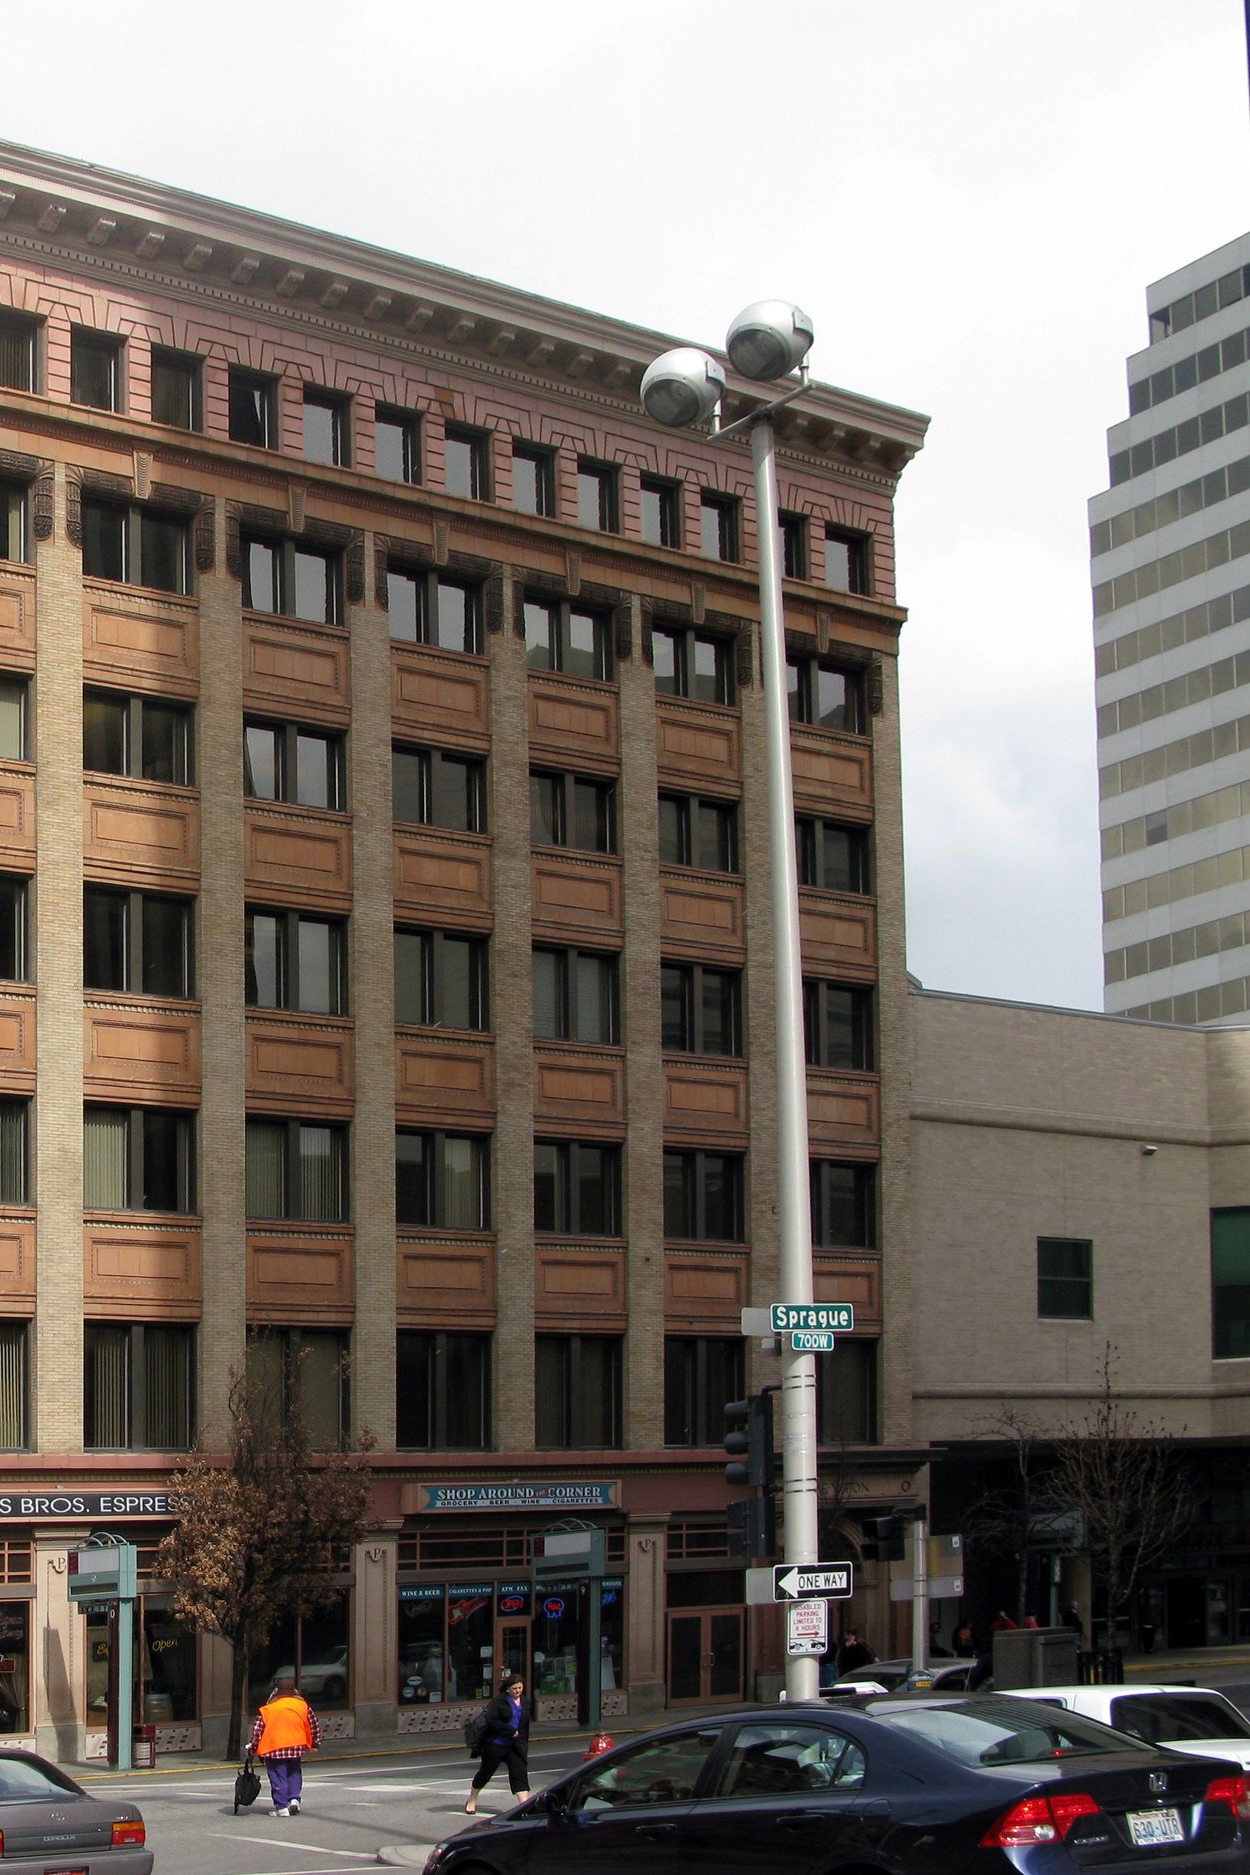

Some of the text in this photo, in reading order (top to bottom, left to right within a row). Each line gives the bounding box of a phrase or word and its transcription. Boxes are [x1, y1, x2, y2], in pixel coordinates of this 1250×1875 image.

[776, 1306, 848, 1328] Sprague
[797, 1333, 828, 1348] 700W
[437, 1488, 475, 1500] SHOP
[478, 1487, 534, 1499] AROUND
[548, 1486, 600, 1498] CORNER
[20, 1497, 90, 1514] BROS.
[798, 1574, 844, 1589] ONE WAY
[502, 1599, 523, 1609] OPEN
[796, 1610, 820, 1618] PARKING
[152, 1639, 178, 1652] Open
